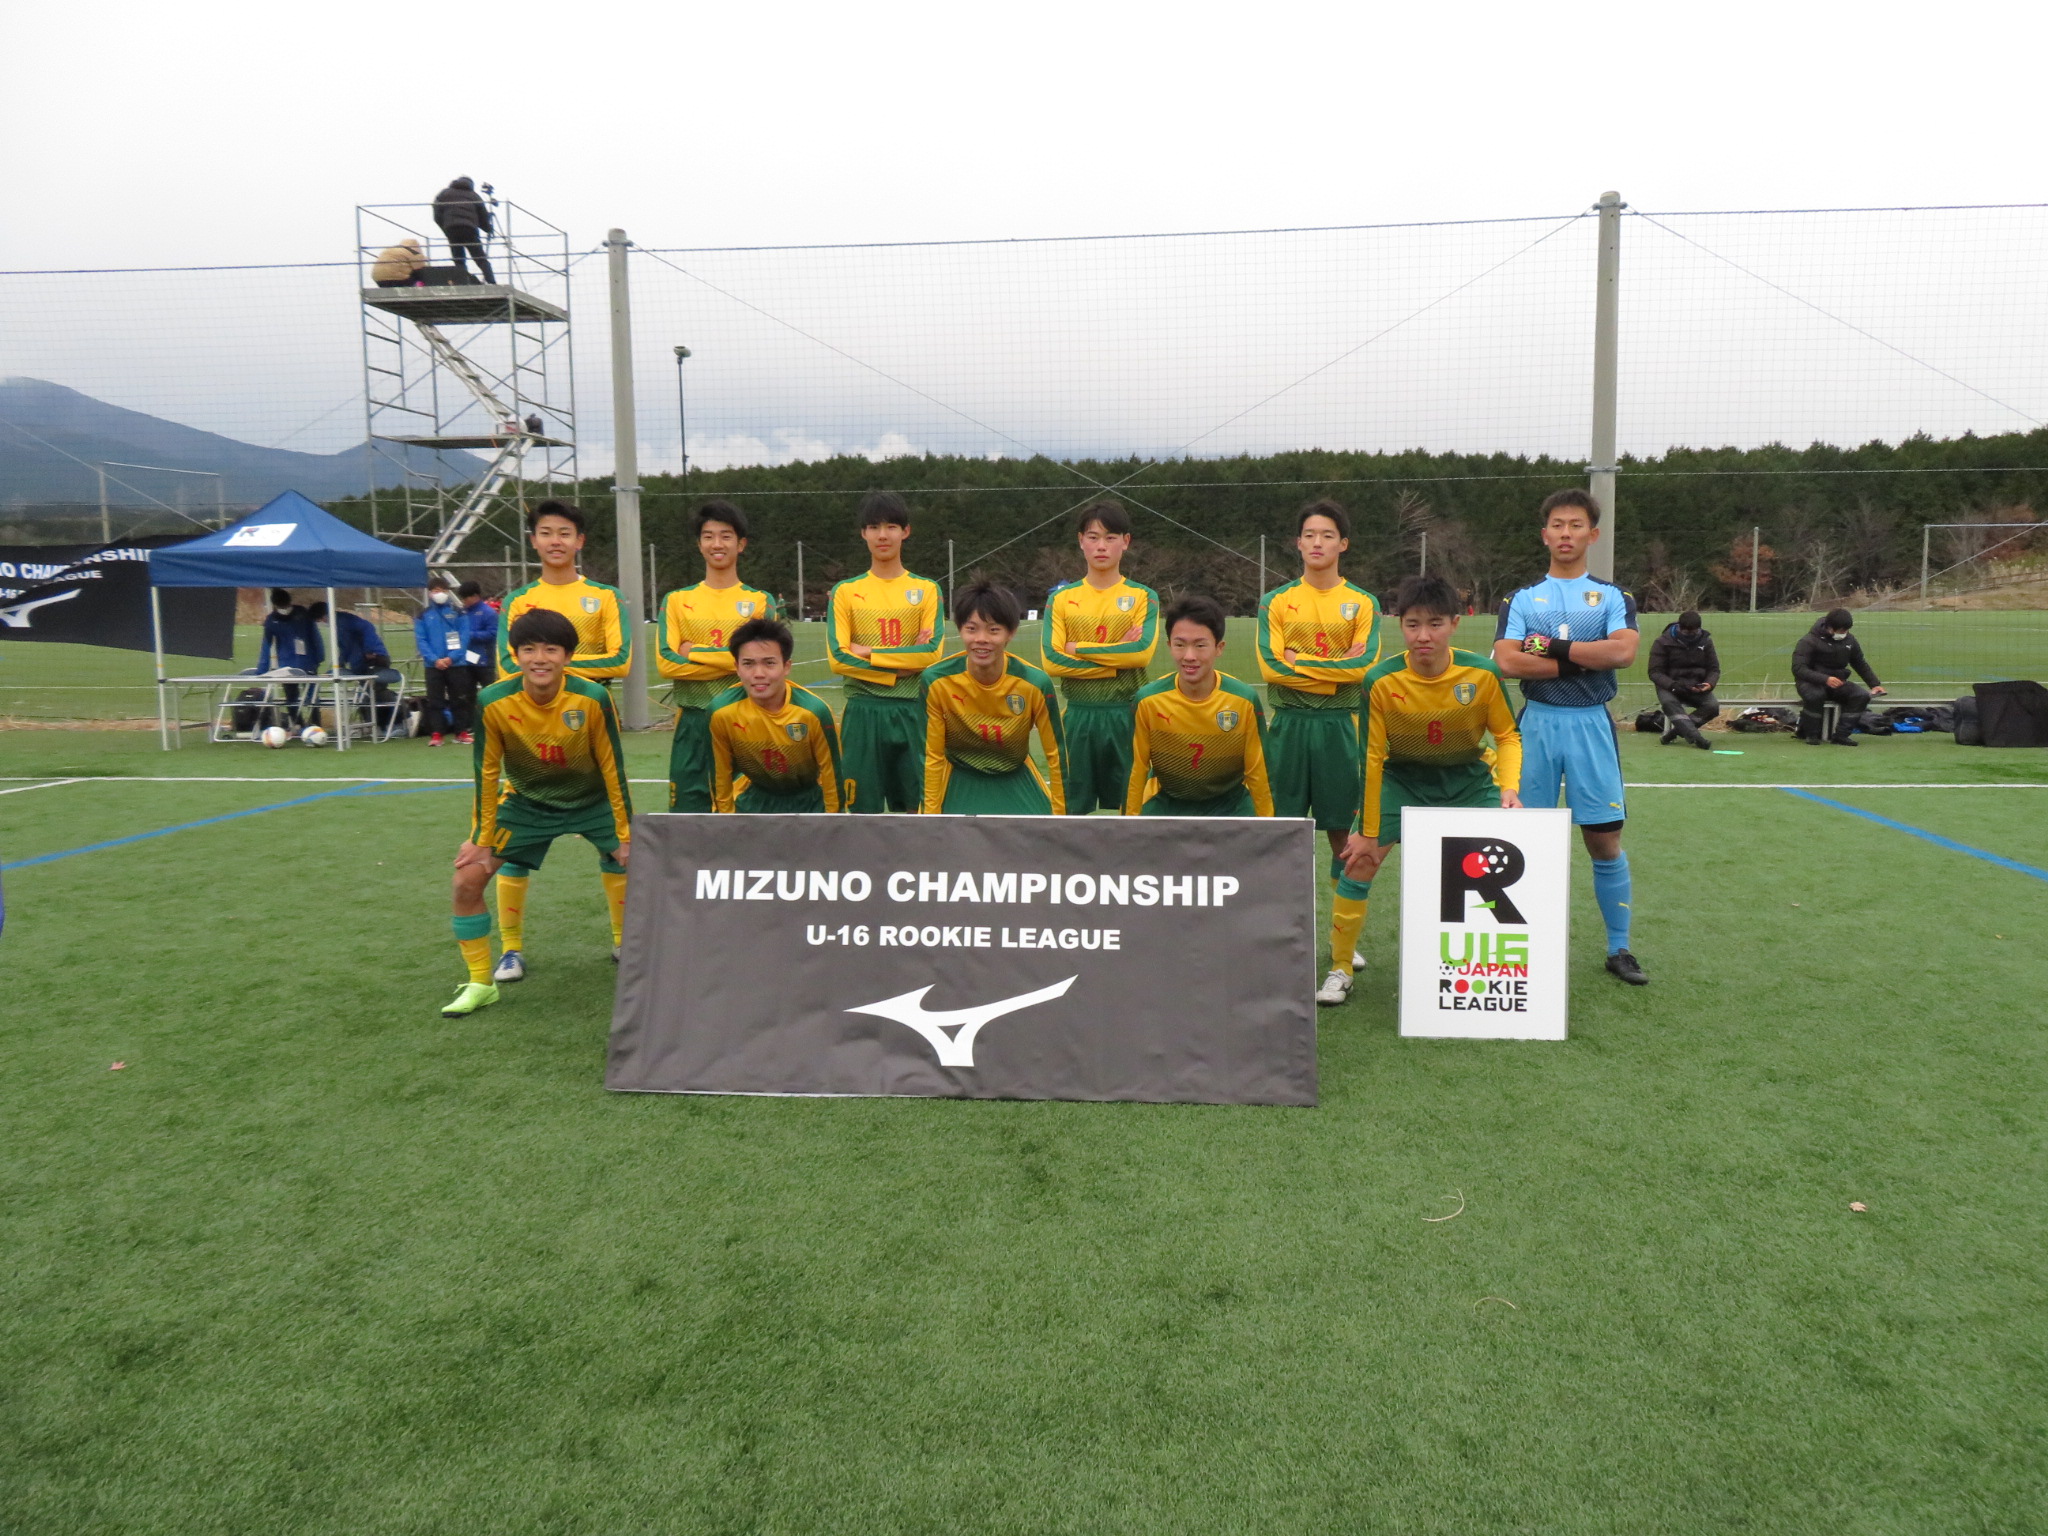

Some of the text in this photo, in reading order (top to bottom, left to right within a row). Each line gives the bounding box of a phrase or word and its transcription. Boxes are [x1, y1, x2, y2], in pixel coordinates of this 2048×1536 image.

[877, 618, 901, 646] 10
[1558, 624, 1570, 641] 1
[1315, 632, 1329, 658] 5
[979, 724, 1005, 747] 11
[1427, 720, 1443, 745] 6
[536, 743, 567, 768] 14
[1188, 743, 1204, 769] 7
[695, 869, 1240, 907] MIZUNO CHAMPIONSHIP
[1440, 836, 1528, 924] R
[806, 924, 1121, 951] U-16 ROOKIE LEAGUE
[1458, 959, 1528, 978] JAPAN
[1440, 979, 1528, 996] ROOKIE
[1439, 996, 1528, 1012] LEAGUE
